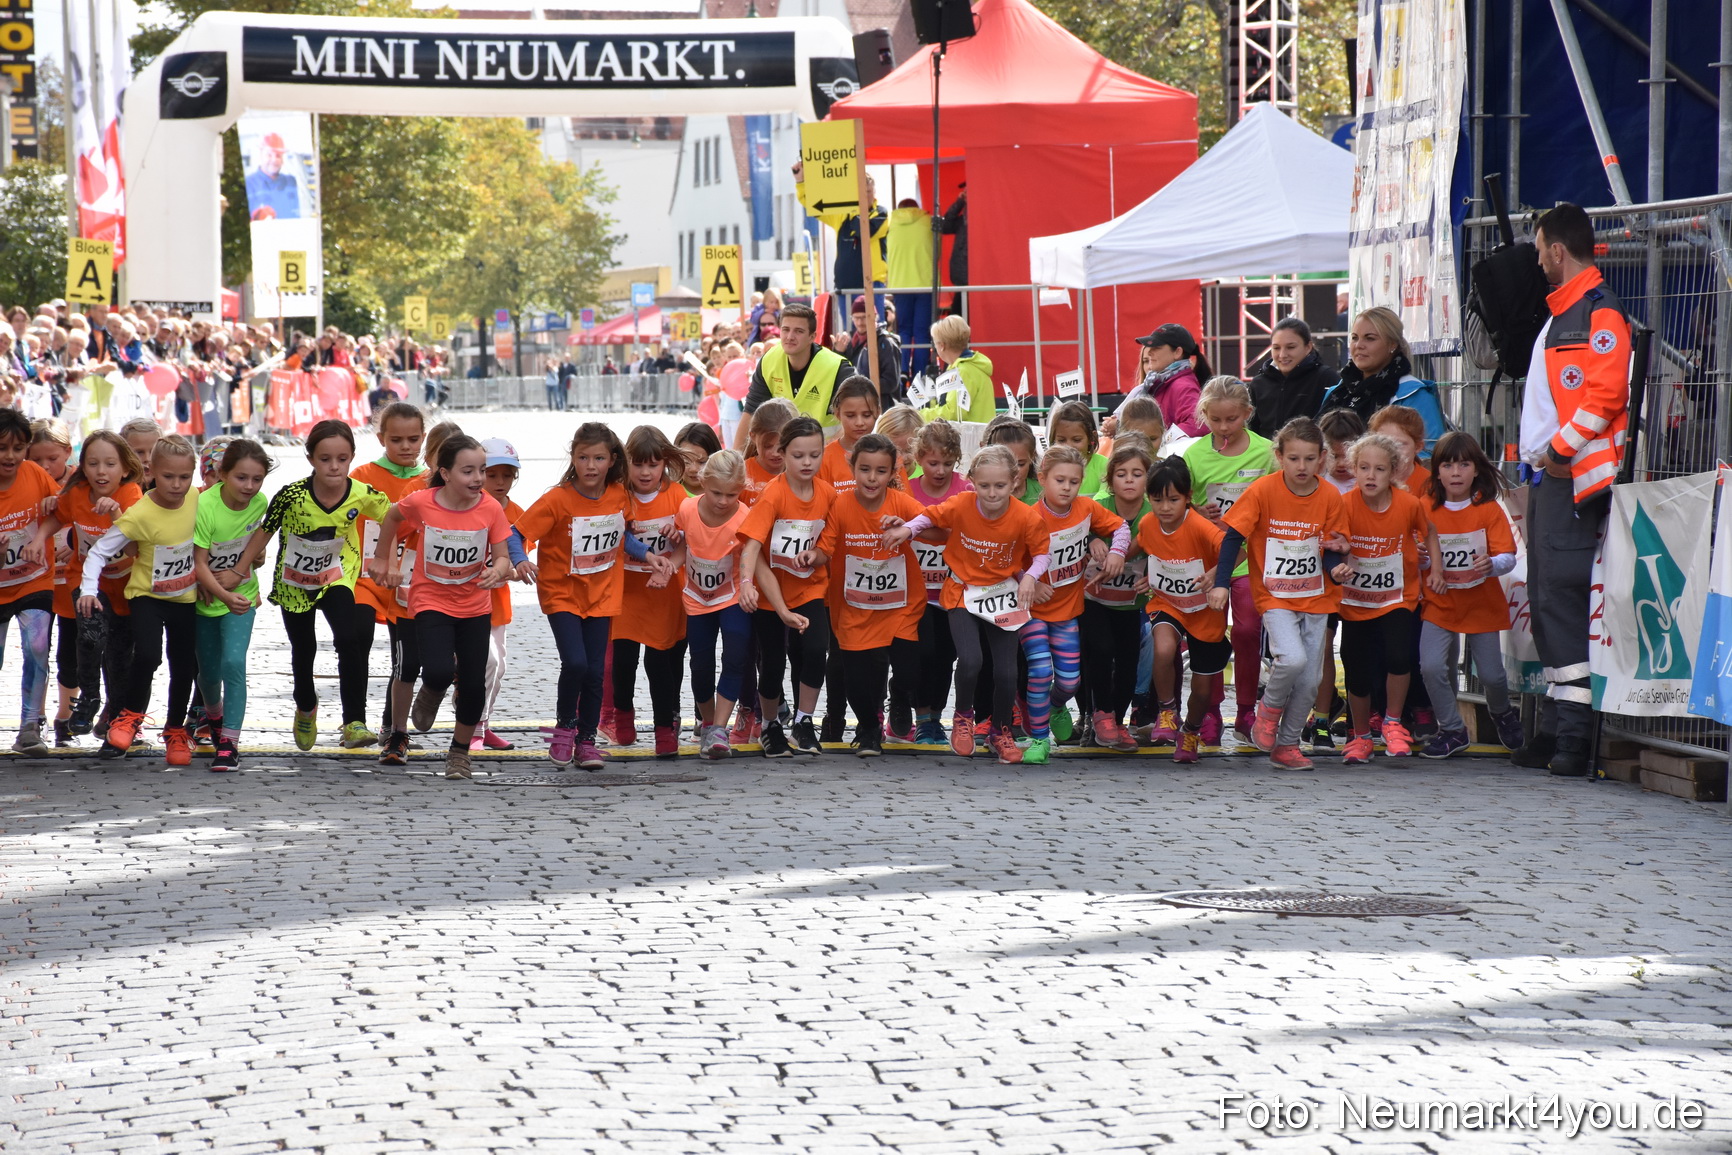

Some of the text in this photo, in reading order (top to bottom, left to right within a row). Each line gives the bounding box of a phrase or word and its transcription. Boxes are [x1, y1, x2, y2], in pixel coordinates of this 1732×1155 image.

[292, 35, 746, 81] MINI NEUMARKT.
[184, 81, 201, 89] MINI
[805, 145, 857, 164] Jugend
[821, 163, 849, 178] lauf
[75, 240, 109, 255] Block
[705, 248, 738, 260] Block
[77, 259, 102, 290] A
[285, 262, 300, 283] B
[711, 264, 735, 295] A
[410, 306, 421, 322] C
[435, 321, 446, 335] D
[689, 321, 699, 333] D
[1060, 379, 1079, 389] swn
[1268, 526, 1303, 538] Stadtlauf
[1269, 518, 1312, 529] Neumarkter
[582, 530, 619, 553] 7178
[638, 535, 667, 552] 76
[845, 539, 879, 548] Stadtlauf
[293, 551, 333, 573] 7259
[433, 545, 478, 564] 7002
[163, 555, 193, 578] 724
[449, 569, 462, 577] Eva
[1275, 556, 1317, 576] 7253
[290, 574, 329, 585] EMMA
[690, 564, 726, 590] 7100
[854, 571, 898, 591] 7192
[1156, 573, 1198, 594] 7262
[1352, 571, 1395, 589] 7248
[974, 591, 1018, 614] 7073
[1651, 688, 1675, 704] Service
